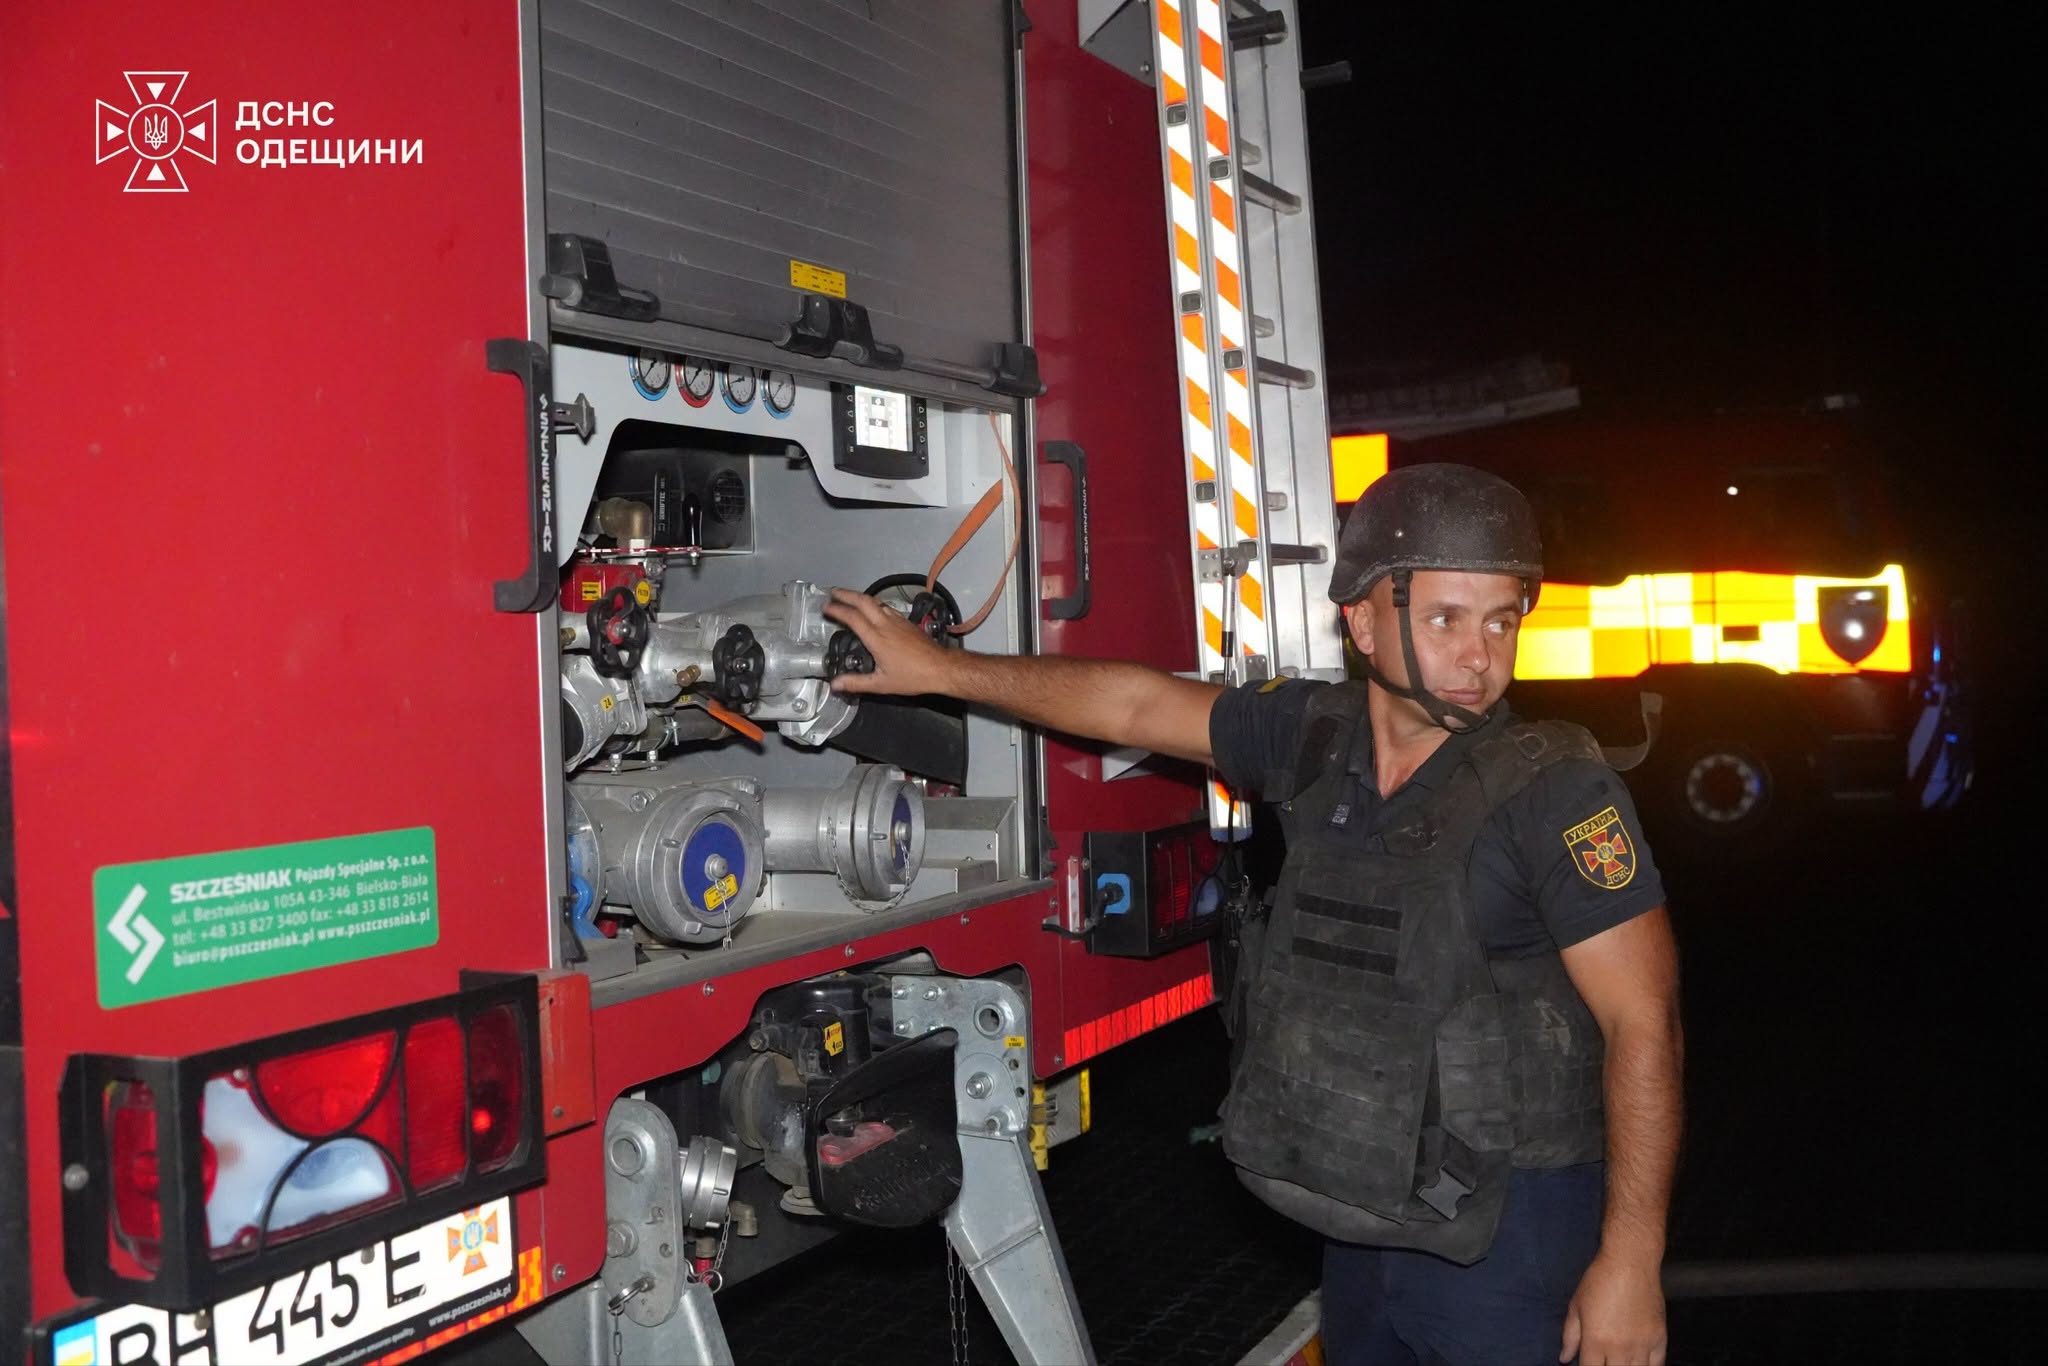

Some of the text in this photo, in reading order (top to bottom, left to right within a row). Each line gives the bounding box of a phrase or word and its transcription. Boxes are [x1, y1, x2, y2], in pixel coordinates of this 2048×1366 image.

[1569, 812, 1613, 841] УКРАЇНА
[170, 854, 429, 905] SZCZĘŚNIAK Pojazdy Specjalne Sp. z o.o.
[172, 909, 190, 926] ul.
[274, 891, 305, 909] 105A
[309, 884, 351, 902] 43-346
[356, 872, 429, 896] Bielsko-Biała
[1606, 866, 1631, 886] ДСНС
[201, 924, 227, 941] +48
[231, 921, 246, 936] 33
[249, 916, 274, 934] 827
[277, 910, 309, 929] 3400
[337, 902, 359, 916] +48
[362, 899, 376, 914] 33
[378, 895, 400, 912] 818
[402, 890, 429, 907] 2614
[317, 907, 431, 940] www.psszczesniak.pl
[248, 1261, 360, 1355] 445
